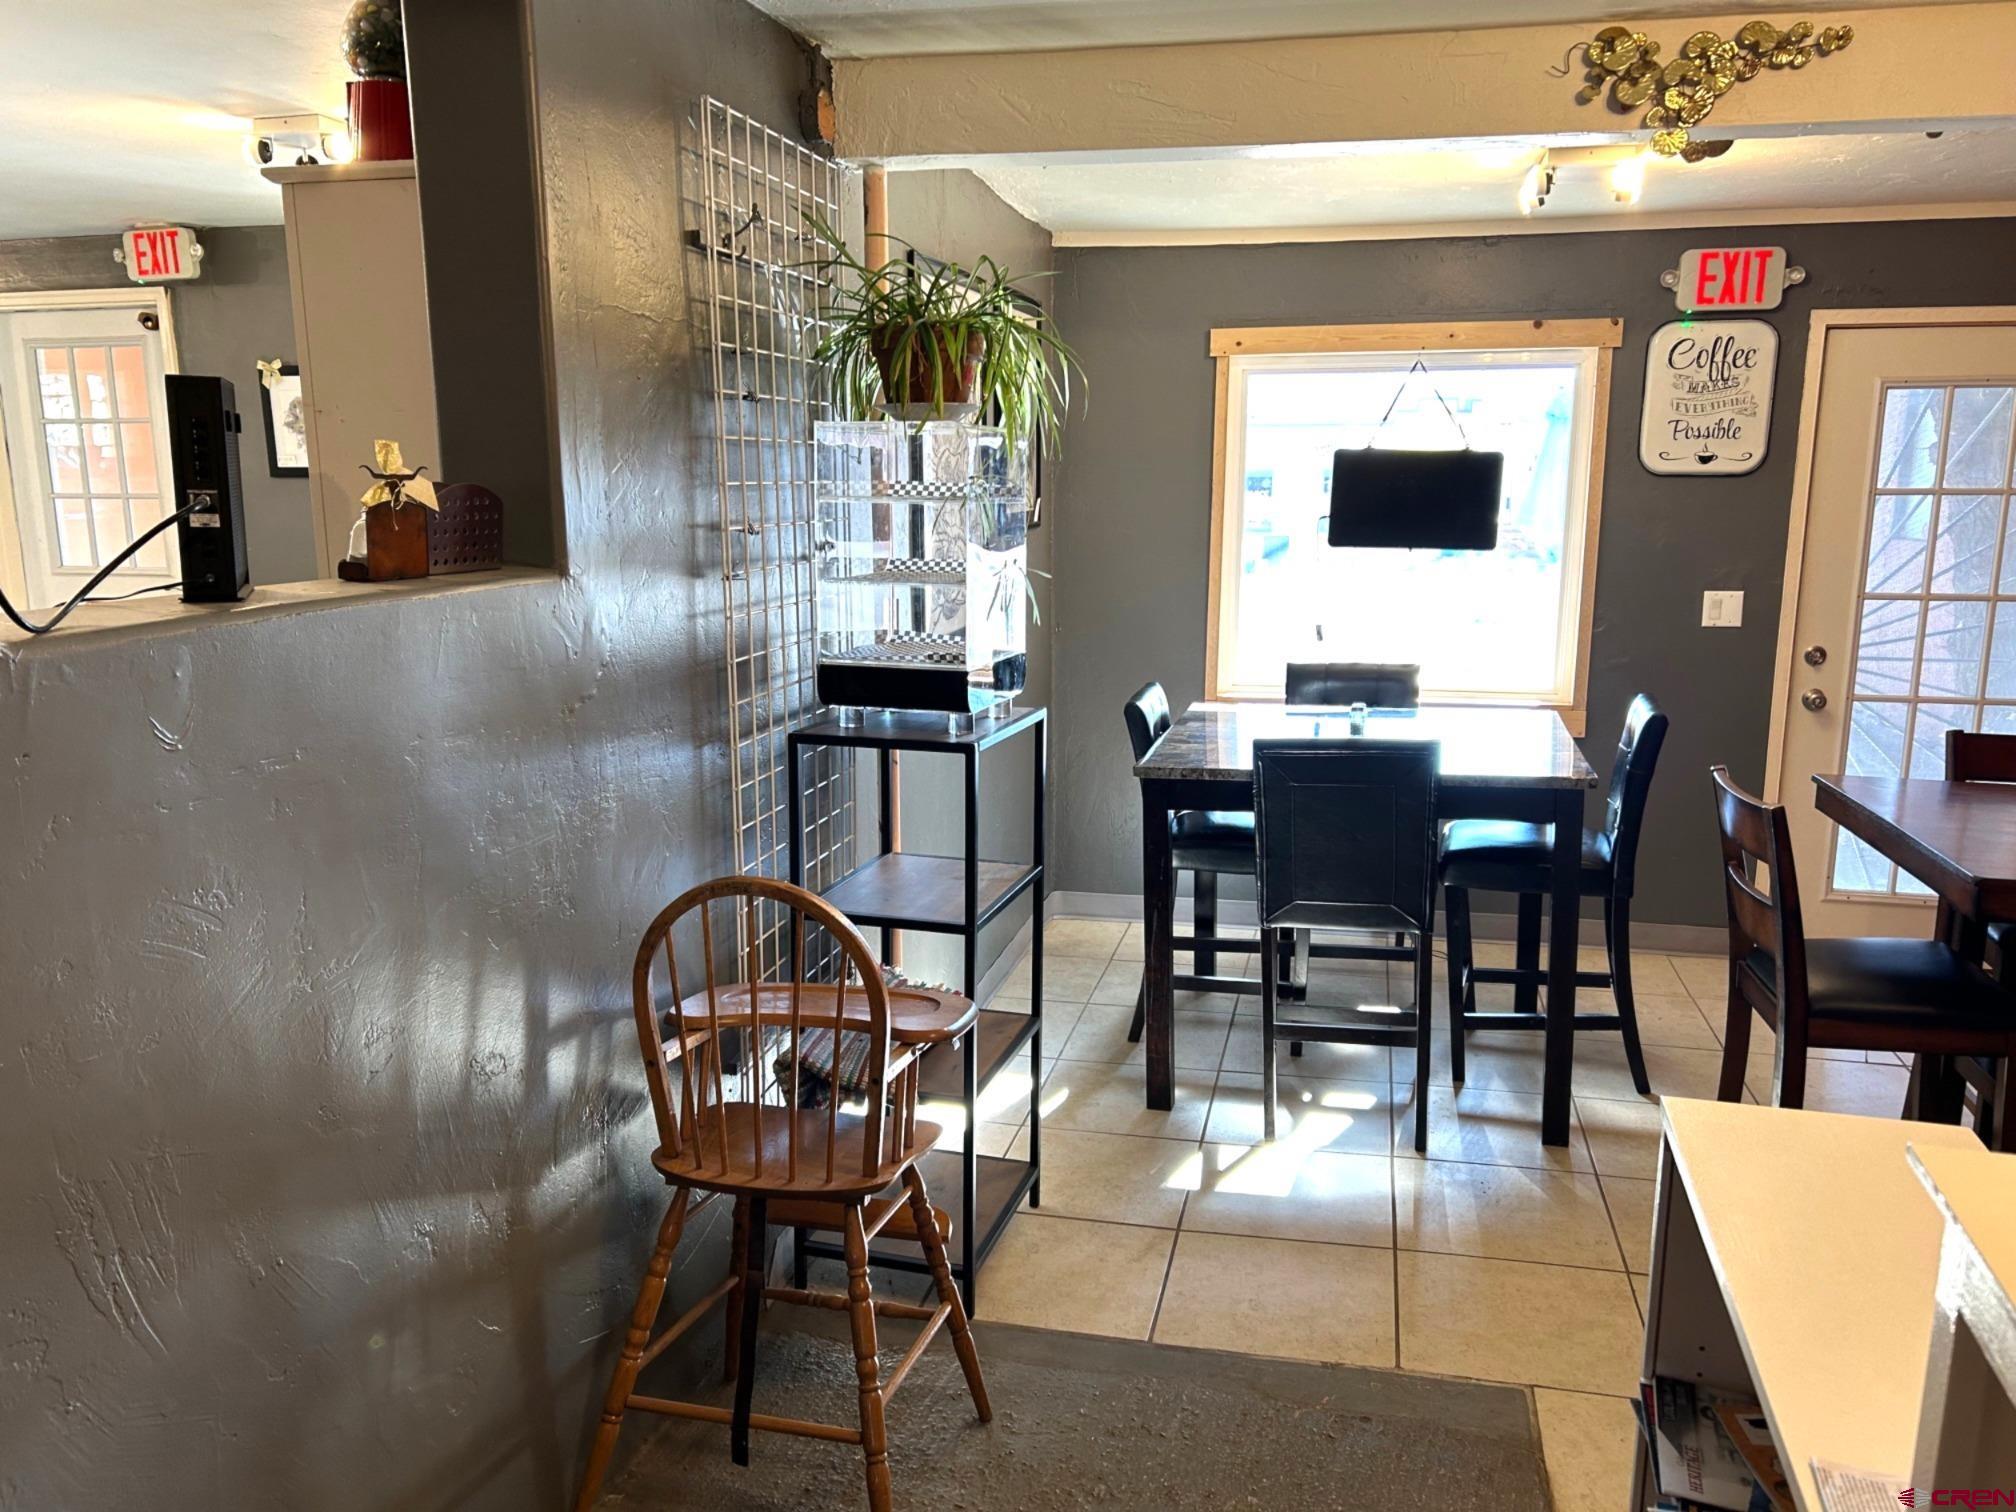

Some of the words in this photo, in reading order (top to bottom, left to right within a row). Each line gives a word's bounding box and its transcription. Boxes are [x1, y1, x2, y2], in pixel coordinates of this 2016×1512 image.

[133, 230, 179, 276] EXIT
[1696, 250, 1773, 305] EXIT
[1667, 336, 1757, 382] Coffee
[1675, 396, 1753, 414] EVERYTHING
[1686, 376, 1740, 394] MAKES
[1667, 417, 1742, 441] Possible
[1684, 1444, 1704, 1495] HERITAGE
